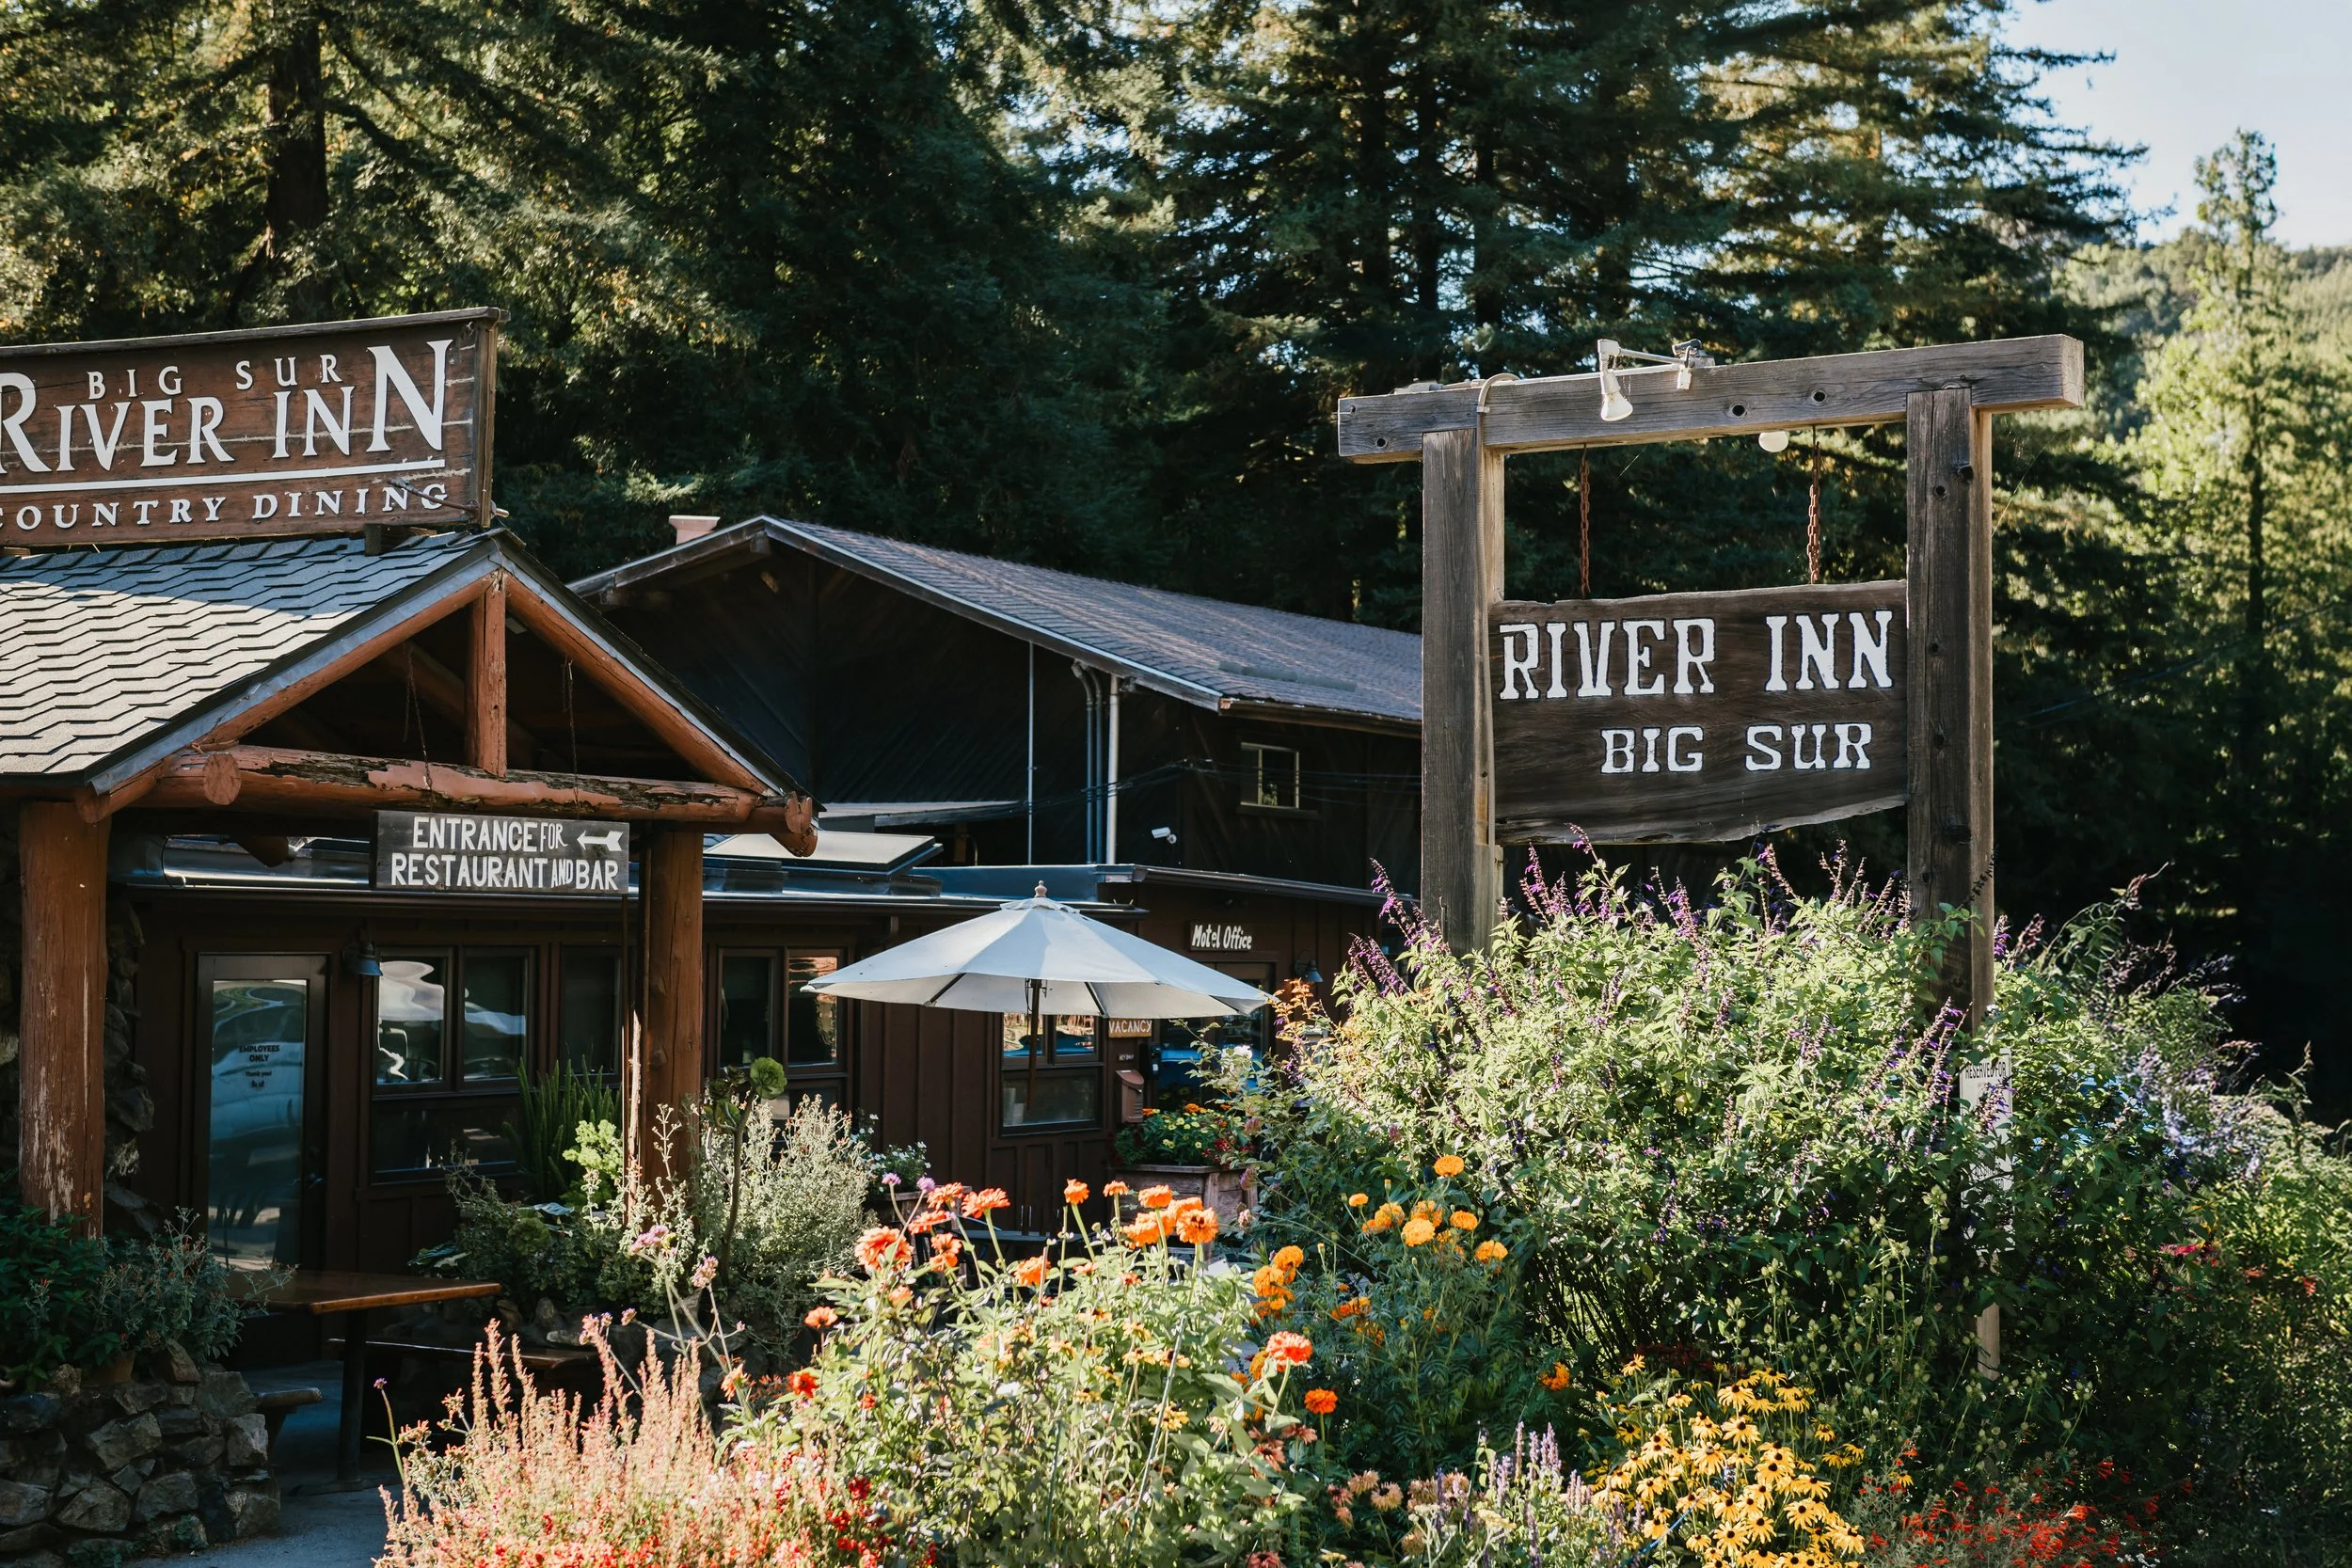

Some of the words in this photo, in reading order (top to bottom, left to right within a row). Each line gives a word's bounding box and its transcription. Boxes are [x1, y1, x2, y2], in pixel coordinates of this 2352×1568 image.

[87, 365, 182, 400] BIG
[235, 354, 342, 390] SUR
[0, 372, 234, 471] RIVER
[272, 339, 453, 459] INN
[252, 483, 448, 519] DINING
[1500, 618, 1715, 700] RIVER
[1765, 610, 1893, 691] INN
[1601, 726, 1704, 774] BIG
[1745, 722, 1872, 771] SUR
[413, 816, 539, 853] ENTRANCE
[540, 822, 568, 852] FOR
[391, 853, 548, 889] RESTAURANT
[550, 859, 573, 888] AND
[576, 859, 618, 891] BAR
[1191, 924, 1221, 948] Motel
[1223, 926, 1252, 950] Office
[1108, 1020, 1152, 1033] VACANCY
[249, 1053, 269, 1062] ONLY
